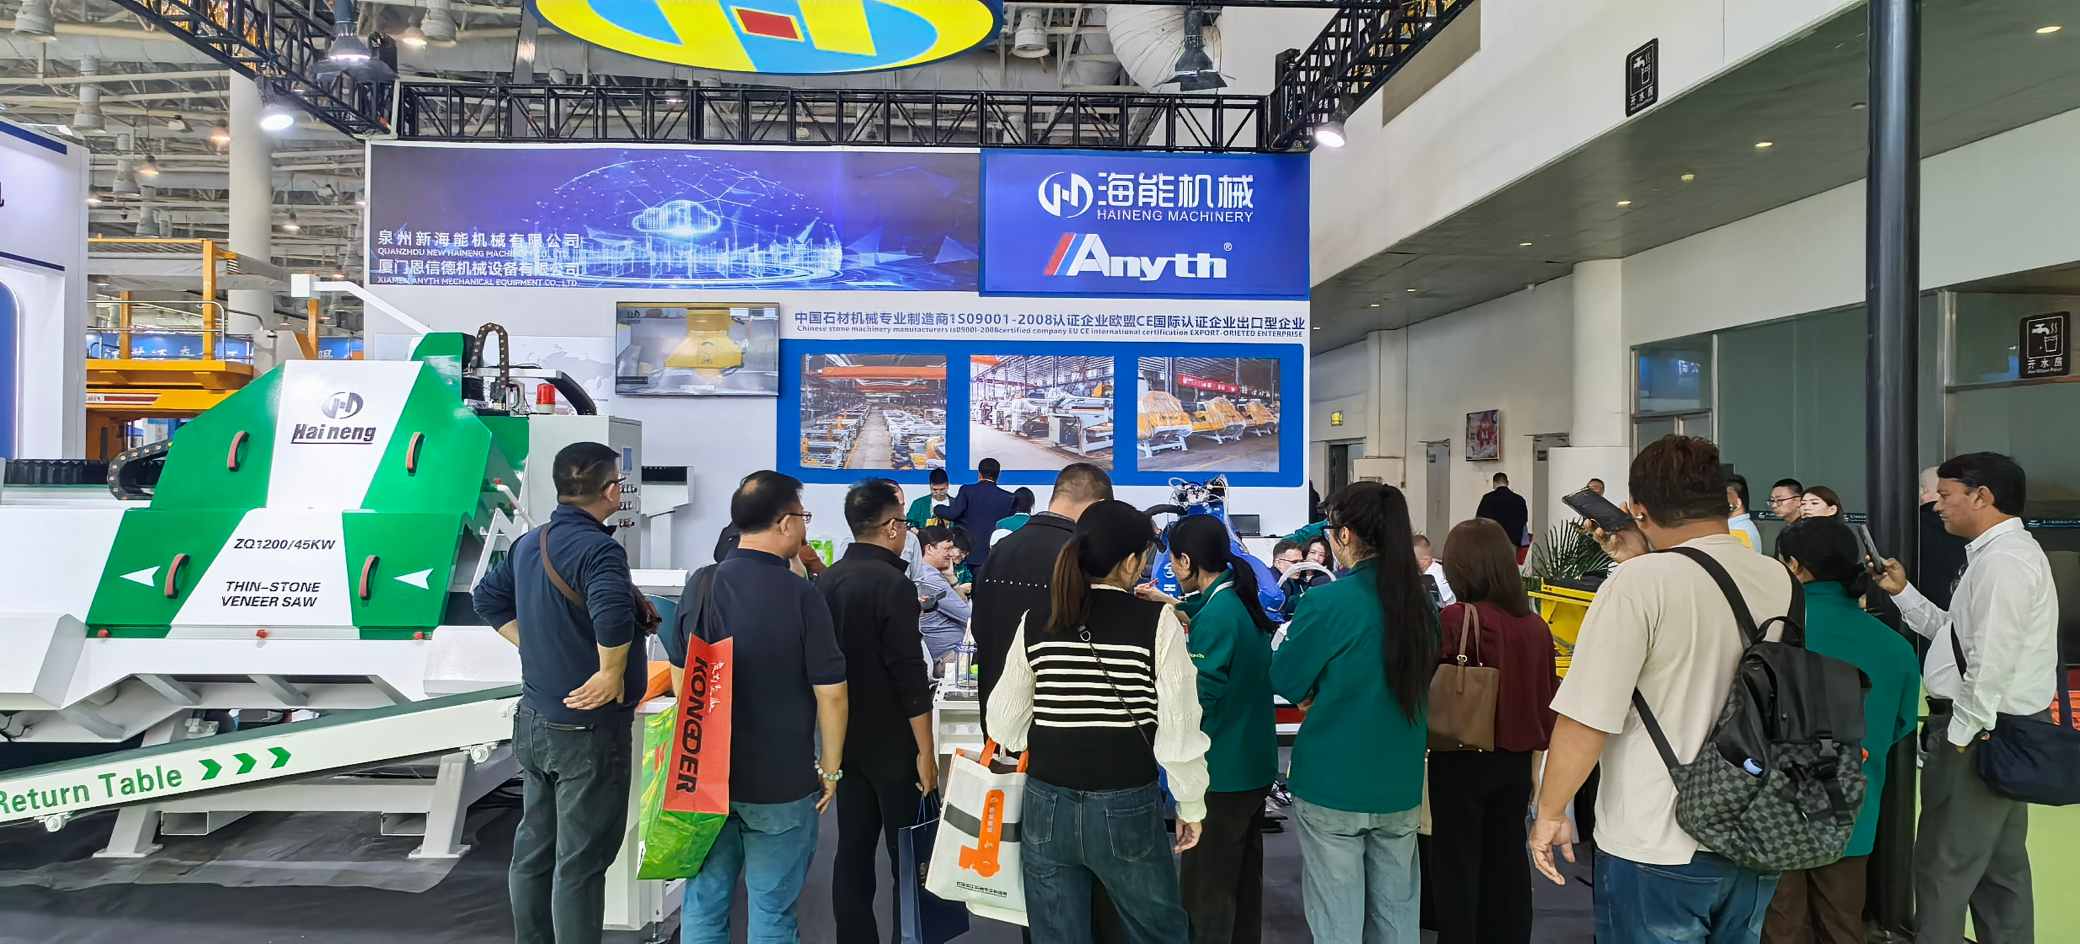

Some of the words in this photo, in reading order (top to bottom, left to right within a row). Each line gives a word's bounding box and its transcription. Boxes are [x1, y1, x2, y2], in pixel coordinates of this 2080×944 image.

[1098, 172, 1254, 209] 海能机械
[1097, 209, 1163, 222] HAINENG
[1168, 210, 1254, 223] MACHINERY
[378, 230, 580, 248] 泉州新海能机械有限公司
[1066, 233, 1228, 281] Anyth
[379, 258, 580, 276] 厦门恩信德机械设备有限公司
[234, 538, 336, 550] ZQ1200/45KW
[222, 595, 280, 607] VENEER
[281, 596, 318, 607] SAW
[0, 784, 90, 814] Return
[98, 765, 183, 799] Table
